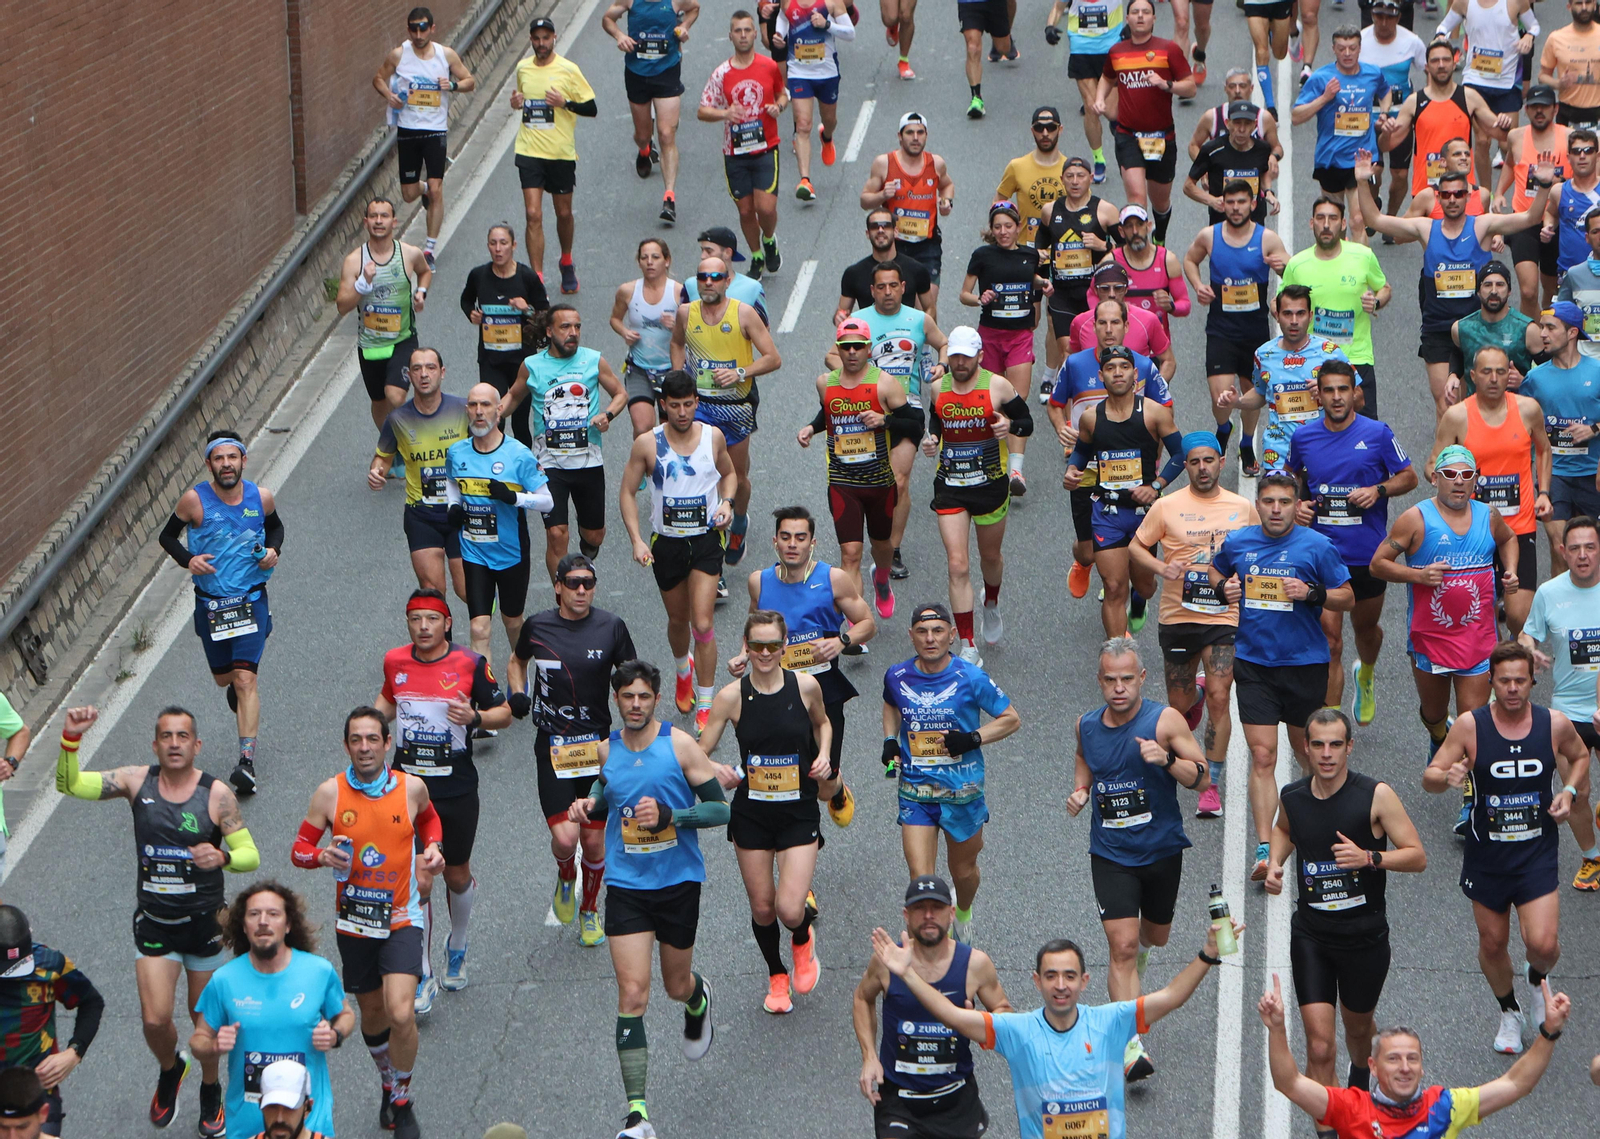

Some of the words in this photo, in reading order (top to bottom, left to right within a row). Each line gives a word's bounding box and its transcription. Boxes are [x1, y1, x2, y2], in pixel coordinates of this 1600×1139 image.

[905, 210, 927, 218] ZURICH
[1004, 283, 1027, 291] ZURICH
[1327, 309, 1351, 318] ZURICH
[710, 361, 733, 369] ZURICH
[884, 367, 907, 375] ZURICH
[1287, 395, 1303, 403] 4621
[830, 398, 871, 414] Gorras
[942, 403, 985, 420] Gorras
[560, 420, 582, 428] ZURICH
[942, 417, 987, 430] runners
[559, 432, 575, 441] 3034
[845, 437, 861, 445] 5730
[1557, 440, 1574, 448] LUCAS
[954, 449, 980, 458] ZURICH
[1110, 451, 1136, 459] ZURICH
[955, 462, 971, 470] 3468
[1111, 464, 1127, 472] 4153
[1108, 474, 1134, 482] LEONARDO
[1489, 475, 1516, 484] ZURICH
[1489, 489, 1506, 498] 3148
[677, 497, 703, 506] ZURICH
[1330, 499, 1347, 508] 3385
[468, 505, 491, 513] ZURICH
[676, 510, 694, 519] 3447
[1328, 510, 1349, 518] MIGUEL
[1261, 567, 1290, 577] ZURICH
[1260, 581, 1278, 591] 5634
[1260, 593, 1278, 601] PETER
[222, 610, 239, 621] 3031
[214, 622, 229, 632] ALEX
[791, 631, 818, 643] ZURICH
[587, 649, 603, 660] XT
[793, 647, 811, 657] 5748
[923, 722, 953, 730] ZURICH
[416, 732, 447, 743] ZURICH
[566, 733, 594, 743] ZURICH
[415, 747, 435, 757] 2233
[568, 749, 586, 758] 4083
[415, 758, 437, 767] DANIEL
[763, 756, 794, 766] ZURICH
[555, 762, 579, 770] DOUDOU
[1489, 758, 1544, 779] GD
[763, 771, 782, 780] 4454
[767, 784, 780, 792] KAT
[1107, 781, 1138, 791] ZURICH
[1110, 797, 1130, 808] 3123
[1503, 795, 1534, 806] ZURICH
[1116, 810, 1130, 819] PGA
[1503, 812, 1524, 821] 3444
[1501, 824, 1528, 833] AJIERRO
[637, 835, 660, 844] TIERRA
[156, 848, 189, 858] ZURICH
[156, 863, 176, 873] 2758
[1321, 878, 1343, 889] 2540
[356, 889, 388, 900] ZURICH
[1321, 890, 1348, 901] CARLOS
[917, 1024, 954, 1035] ZURICH
[916, 1042, 939, 1052] 3035
[917, 1055, 937, 1064] RAUL
[1063, 1101, 1101, 1114] ZURICH
[1064, 1120, 1087, 1132] 6067
